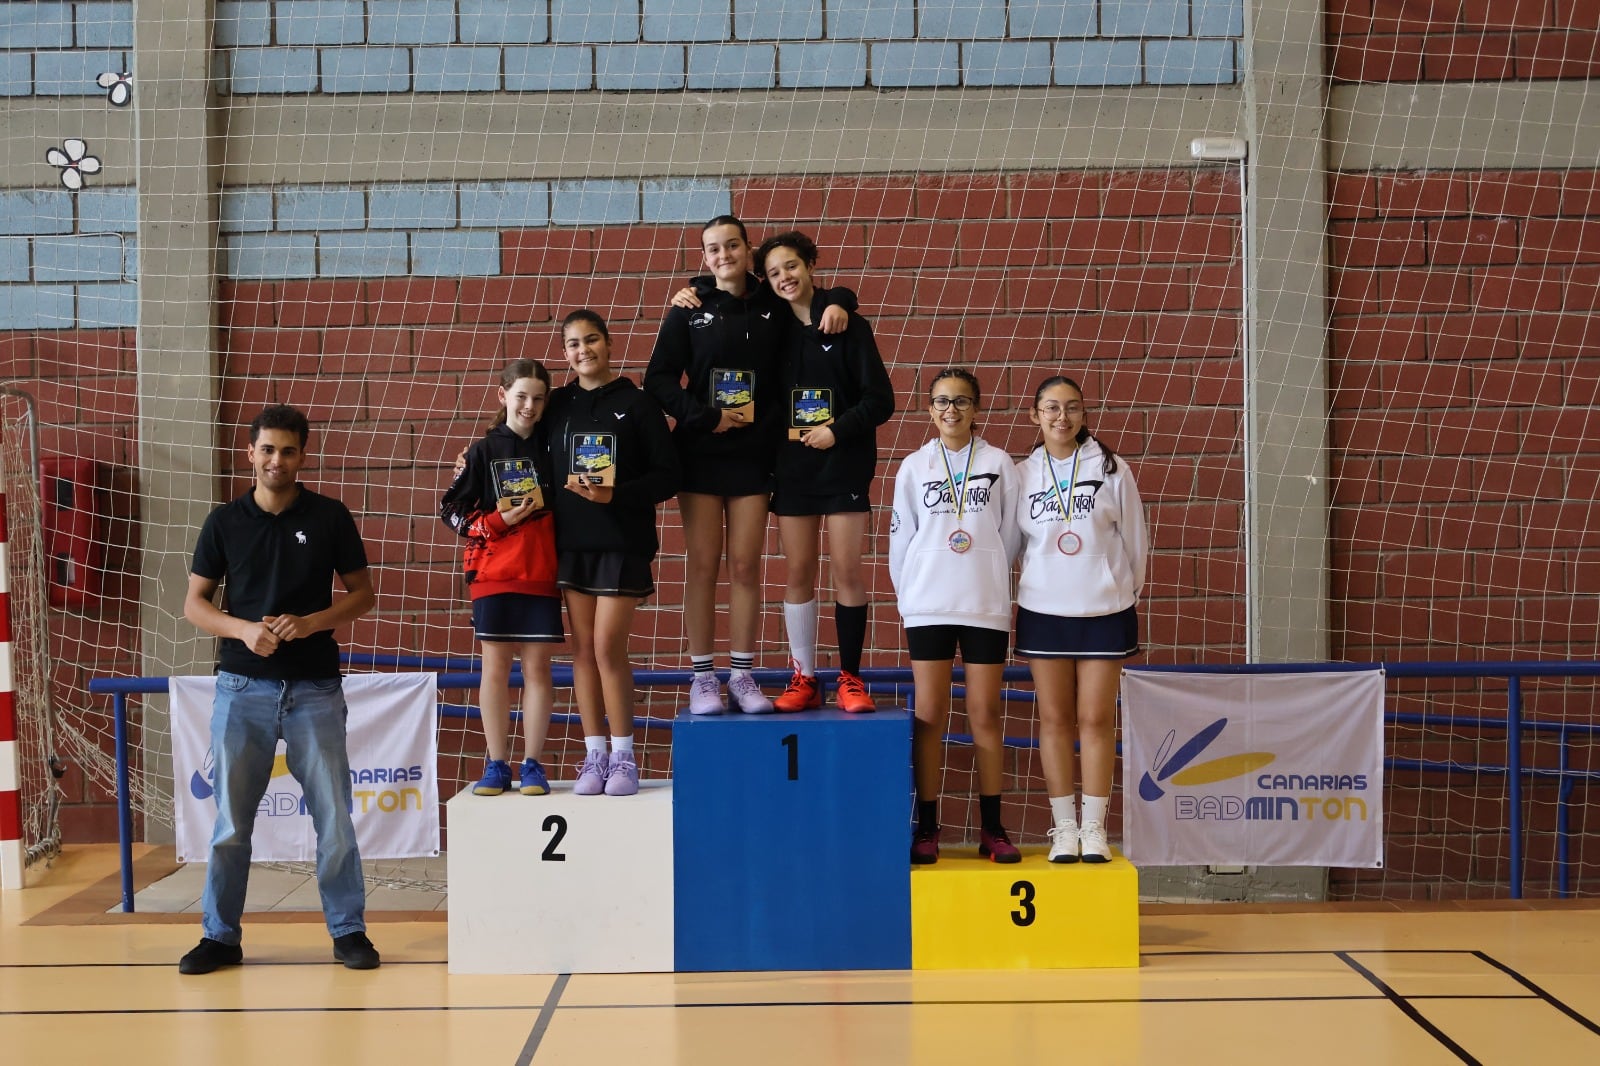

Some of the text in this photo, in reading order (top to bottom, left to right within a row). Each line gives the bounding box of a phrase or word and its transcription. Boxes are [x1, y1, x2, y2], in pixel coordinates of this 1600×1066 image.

[781, 734, 799, 780] 1
[349, 766, 422, 784] NARIAS
[1257, 774, 1367, 790] CANARIAS
[1174, 795, 1367, 820] BADMINTON
[541, 815, 567, 862] 2
[1010, 880, 1036, 927] 3
